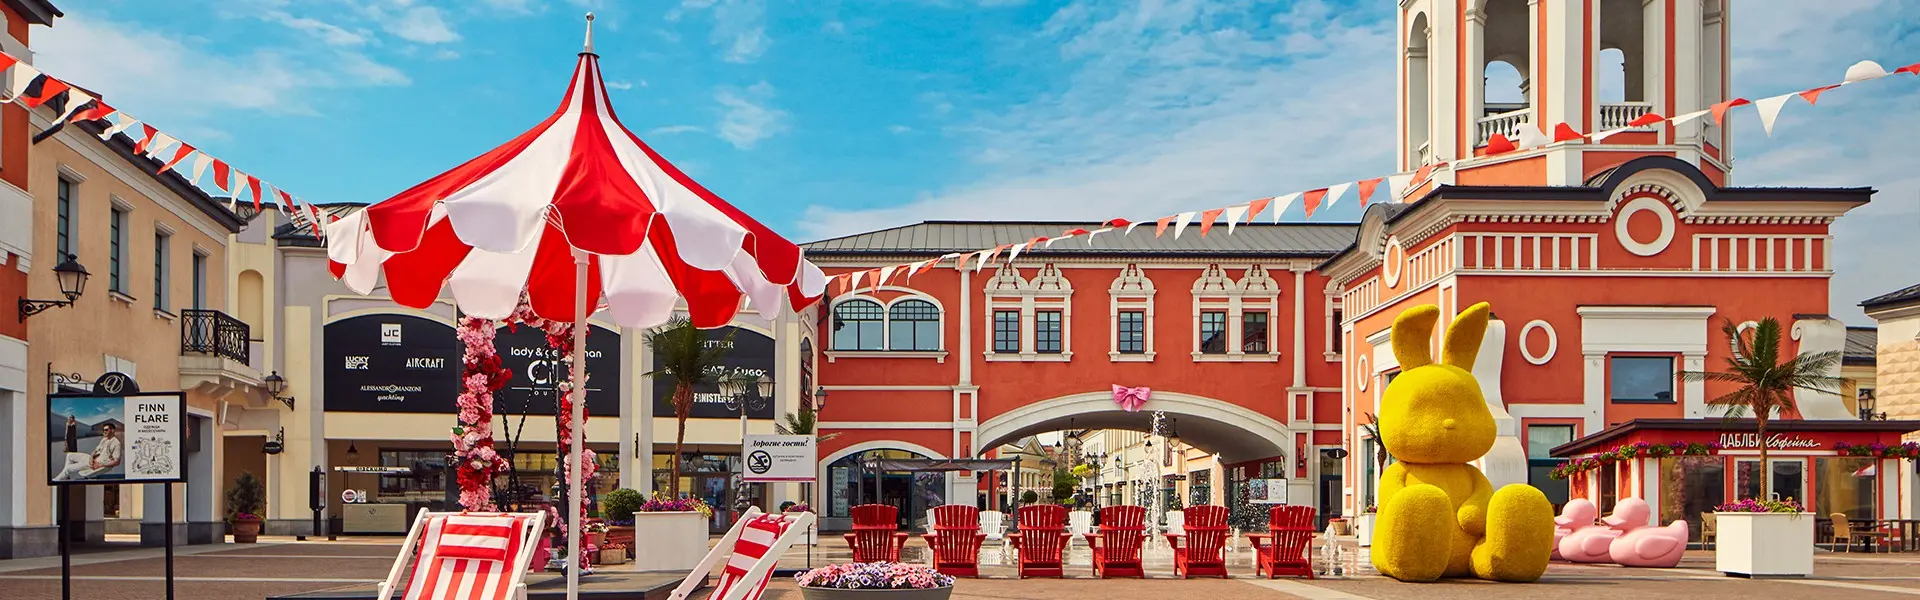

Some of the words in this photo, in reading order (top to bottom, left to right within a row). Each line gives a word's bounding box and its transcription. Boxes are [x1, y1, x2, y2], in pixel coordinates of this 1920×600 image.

[384, 329, 399, 337] JC
[510, 346, 533, 358] lady
[406, 358, 444, 369] AIRCRAFT
[139, 403, 164, 412] FINN
[135, 414, 168, 422] FLARE
